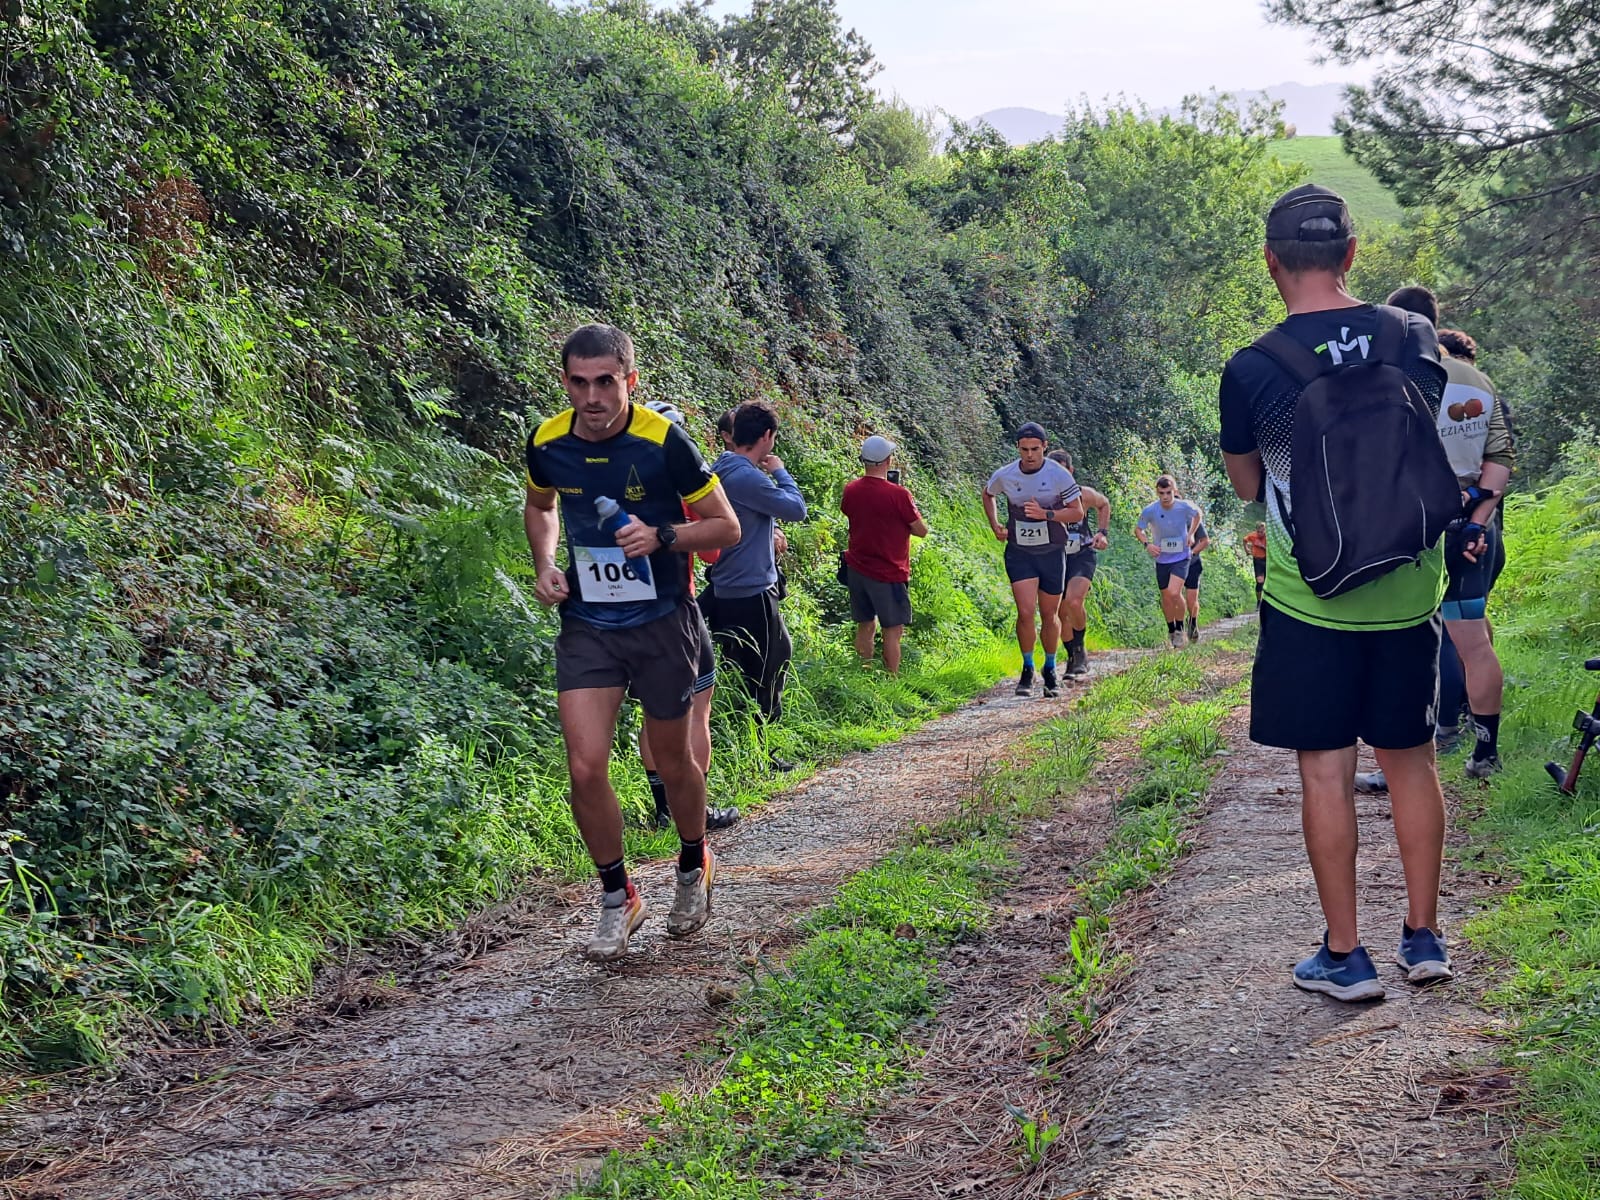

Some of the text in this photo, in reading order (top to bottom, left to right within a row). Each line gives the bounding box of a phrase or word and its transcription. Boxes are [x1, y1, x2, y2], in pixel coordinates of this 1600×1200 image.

[1438, 420, 1489, 438] EZIARTUA
[1020, 528, 1041, 537] 221
[589, 563, 637, 582] 106
